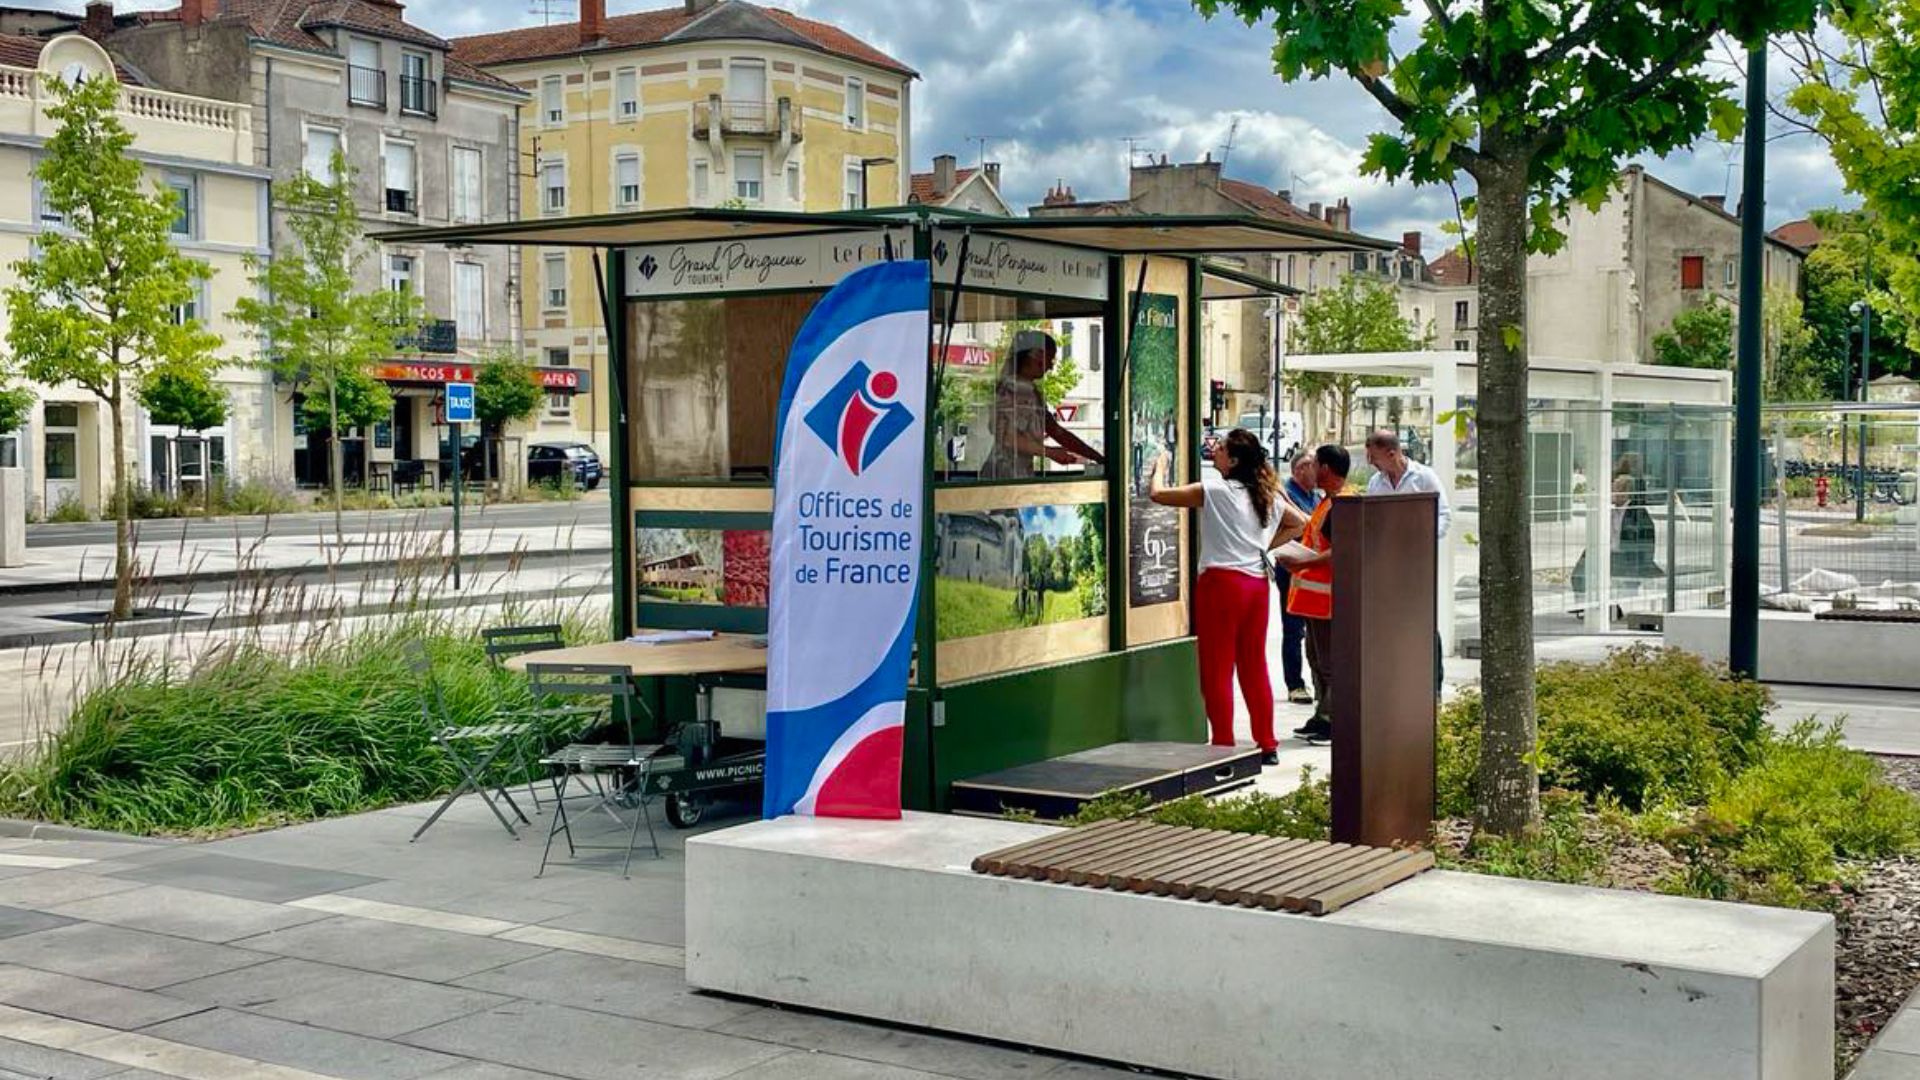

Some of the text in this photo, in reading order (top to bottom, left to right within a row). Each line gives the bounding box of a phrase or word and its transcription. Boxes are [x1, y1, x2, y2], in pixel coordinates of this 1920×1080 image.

[670, 246, 721, 286] Grand
[963, 347, 990, 364] AVIS
[406, 366, 444, 380] TACOS
[450, 396, 472, 409] TAXIS
[799, 492, 912, 518] Offices de
[799, 525, 911, 551] Tourisme
[795, 558, 911, 584] de France
